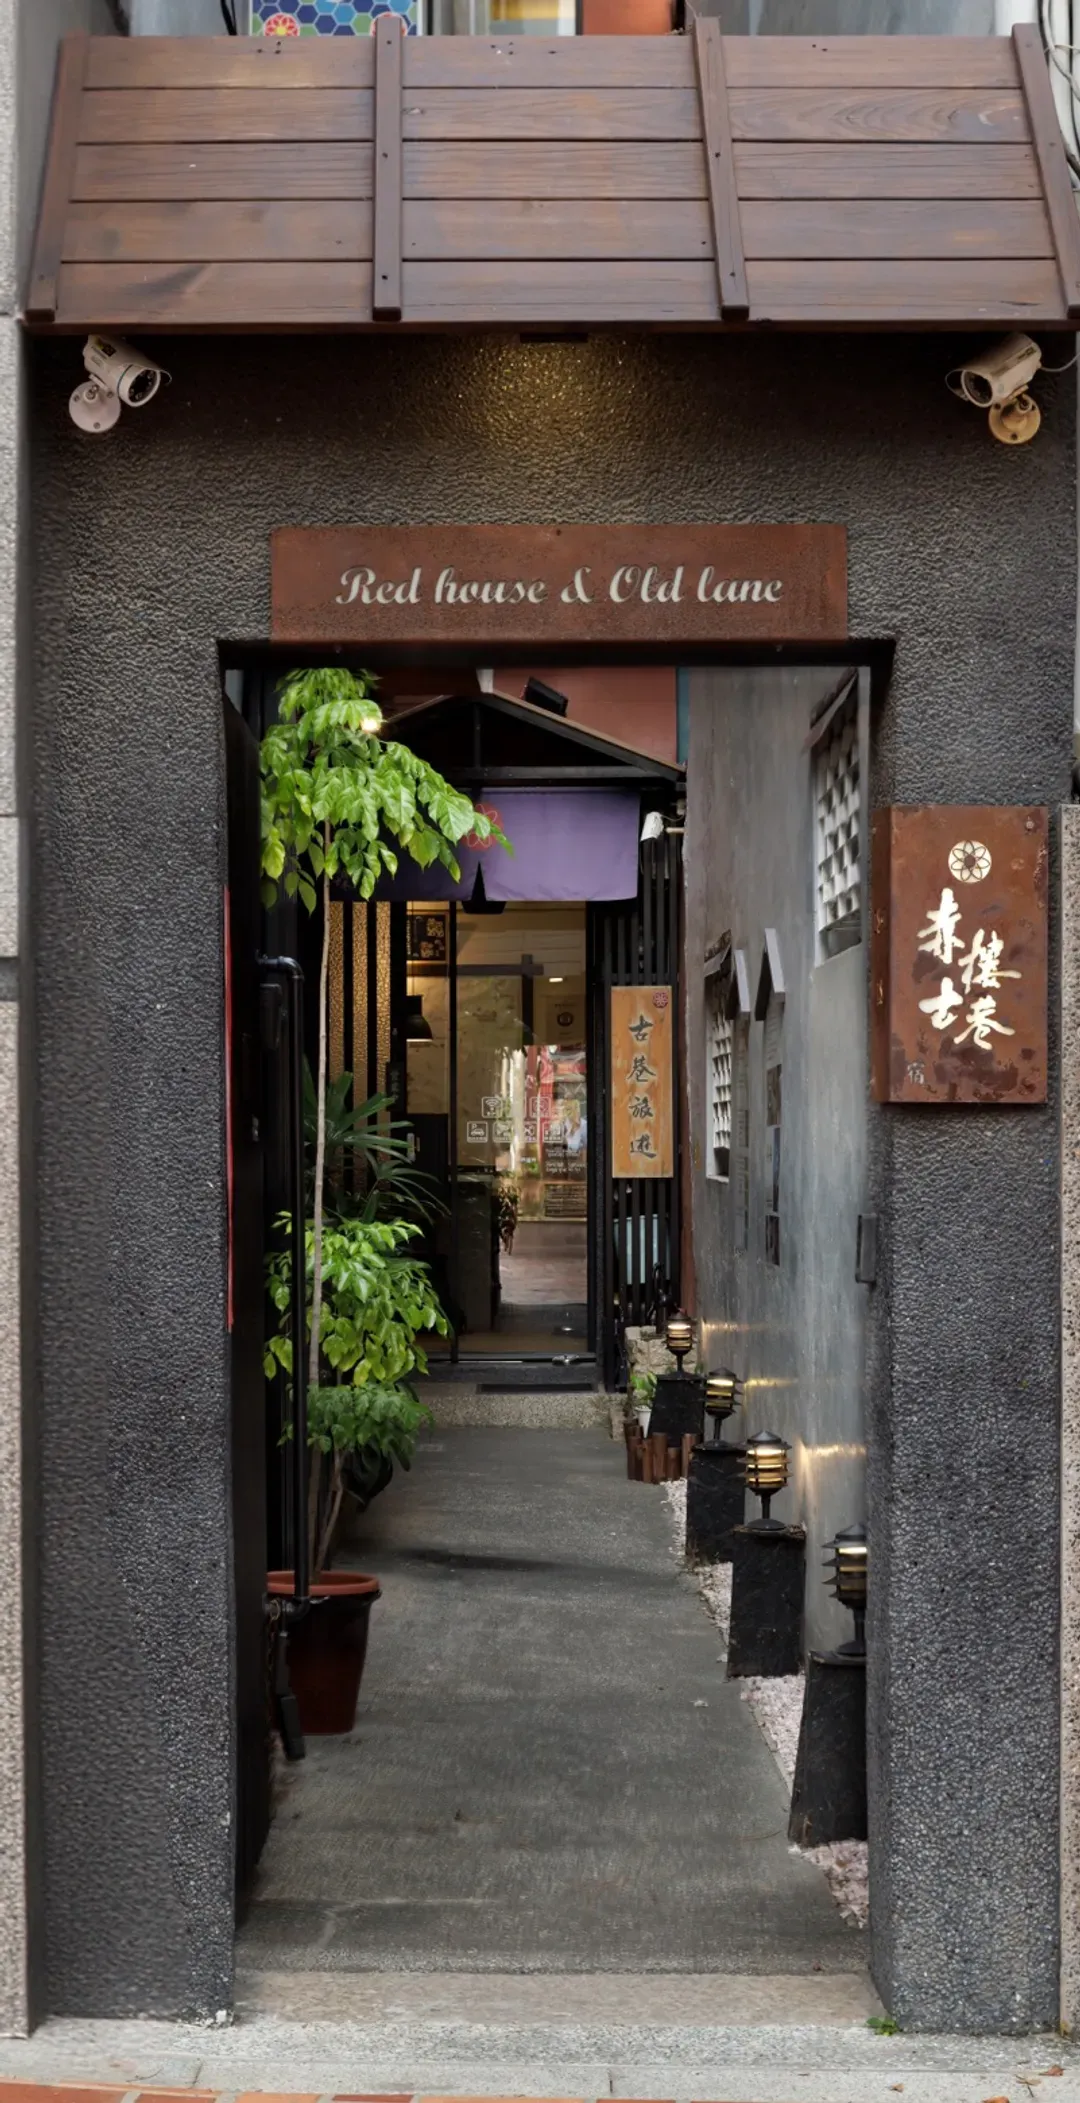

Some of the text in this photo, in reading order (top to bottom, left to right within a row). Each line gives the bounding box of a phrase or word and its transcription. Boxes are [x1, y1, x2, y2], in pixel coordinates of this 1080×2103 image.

[334, 565, 783, 605] Red house & Old lane
